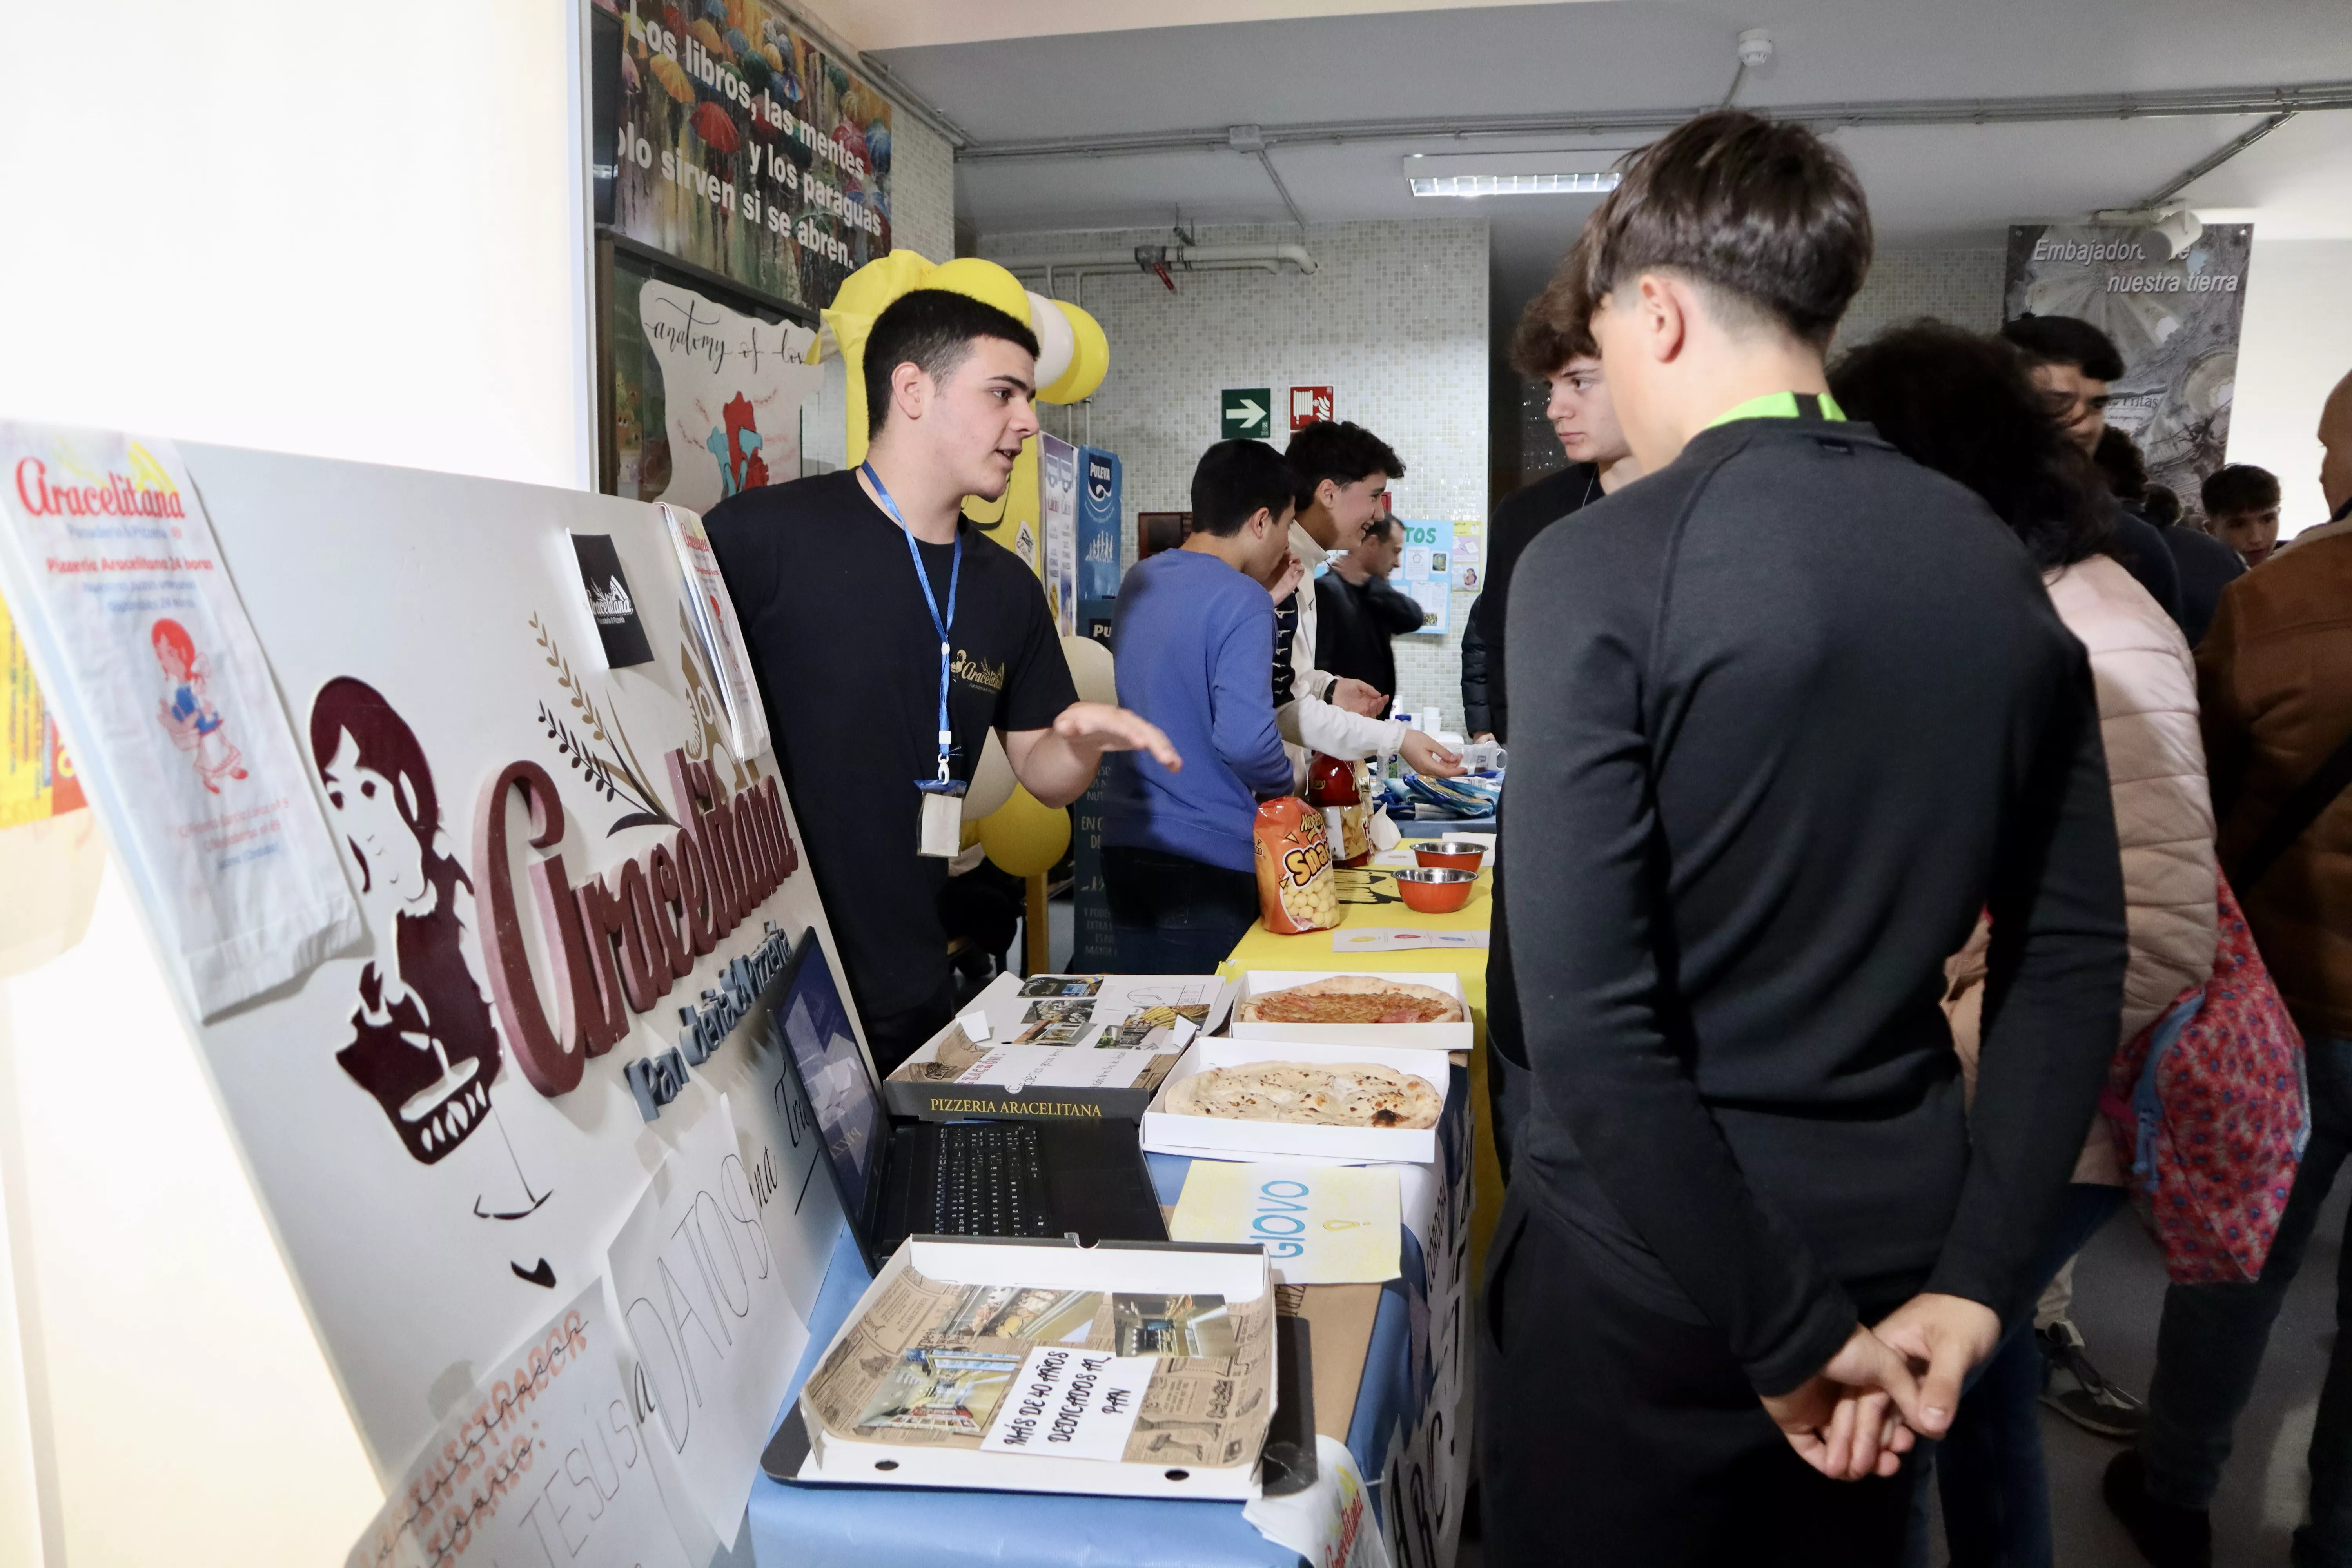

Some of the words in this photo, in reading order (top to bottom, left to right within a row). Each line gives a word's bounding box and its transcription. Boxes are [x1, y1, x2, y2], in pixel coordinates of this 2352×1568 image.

[630, 0, 677, 61] Los
[686, 44, 757, 121] libros,
[764, 86, 793, 136] las
[800, 121, 865, 180] mentes
[748, 140, 763, 176] y
[768, 143, 798, 190] los
[803, 172, 882, 236] paraguas
[661, 148, 735, 212] sirven
[742, 189, 761, 225] si
[768, 206, 792, 237] se
[797, 219, 854, 269] abren.
[2033, 238, 2147, 266] Embajador
[2106, 271, 2181, 294] nuestra
[2186, 269, 2239, 293] tierra
[644, 297, 731, 374] anatomy
[738, 327, 764, 374] of
[772, 328, 806, 365] lov
[15, 456, 186, 519] Aracelitana
[1090, 461, 1111, 482] PULEVA
[1405, 526, 1437, 544] TOS
[930, 1098, 996, 1113] PIZZERIA
[999, 1100, 1103, 1118] ARACELITANA
[1250, 1180, 1310, 1258] GIOVO
[626, 1154, 768, 1454] DATOS
[1035, 1350, 1069, 1382] AÑOS
[1019, 1398, 1046, 1416] DE
[1048, 1373, 1098, 1443] DEDICADOS
[1080, 1356, 1112, 1372] AL
[1101, 1387, 1131, 1415] PAN
[1004, 1418, 1037, 1446] MÁS
